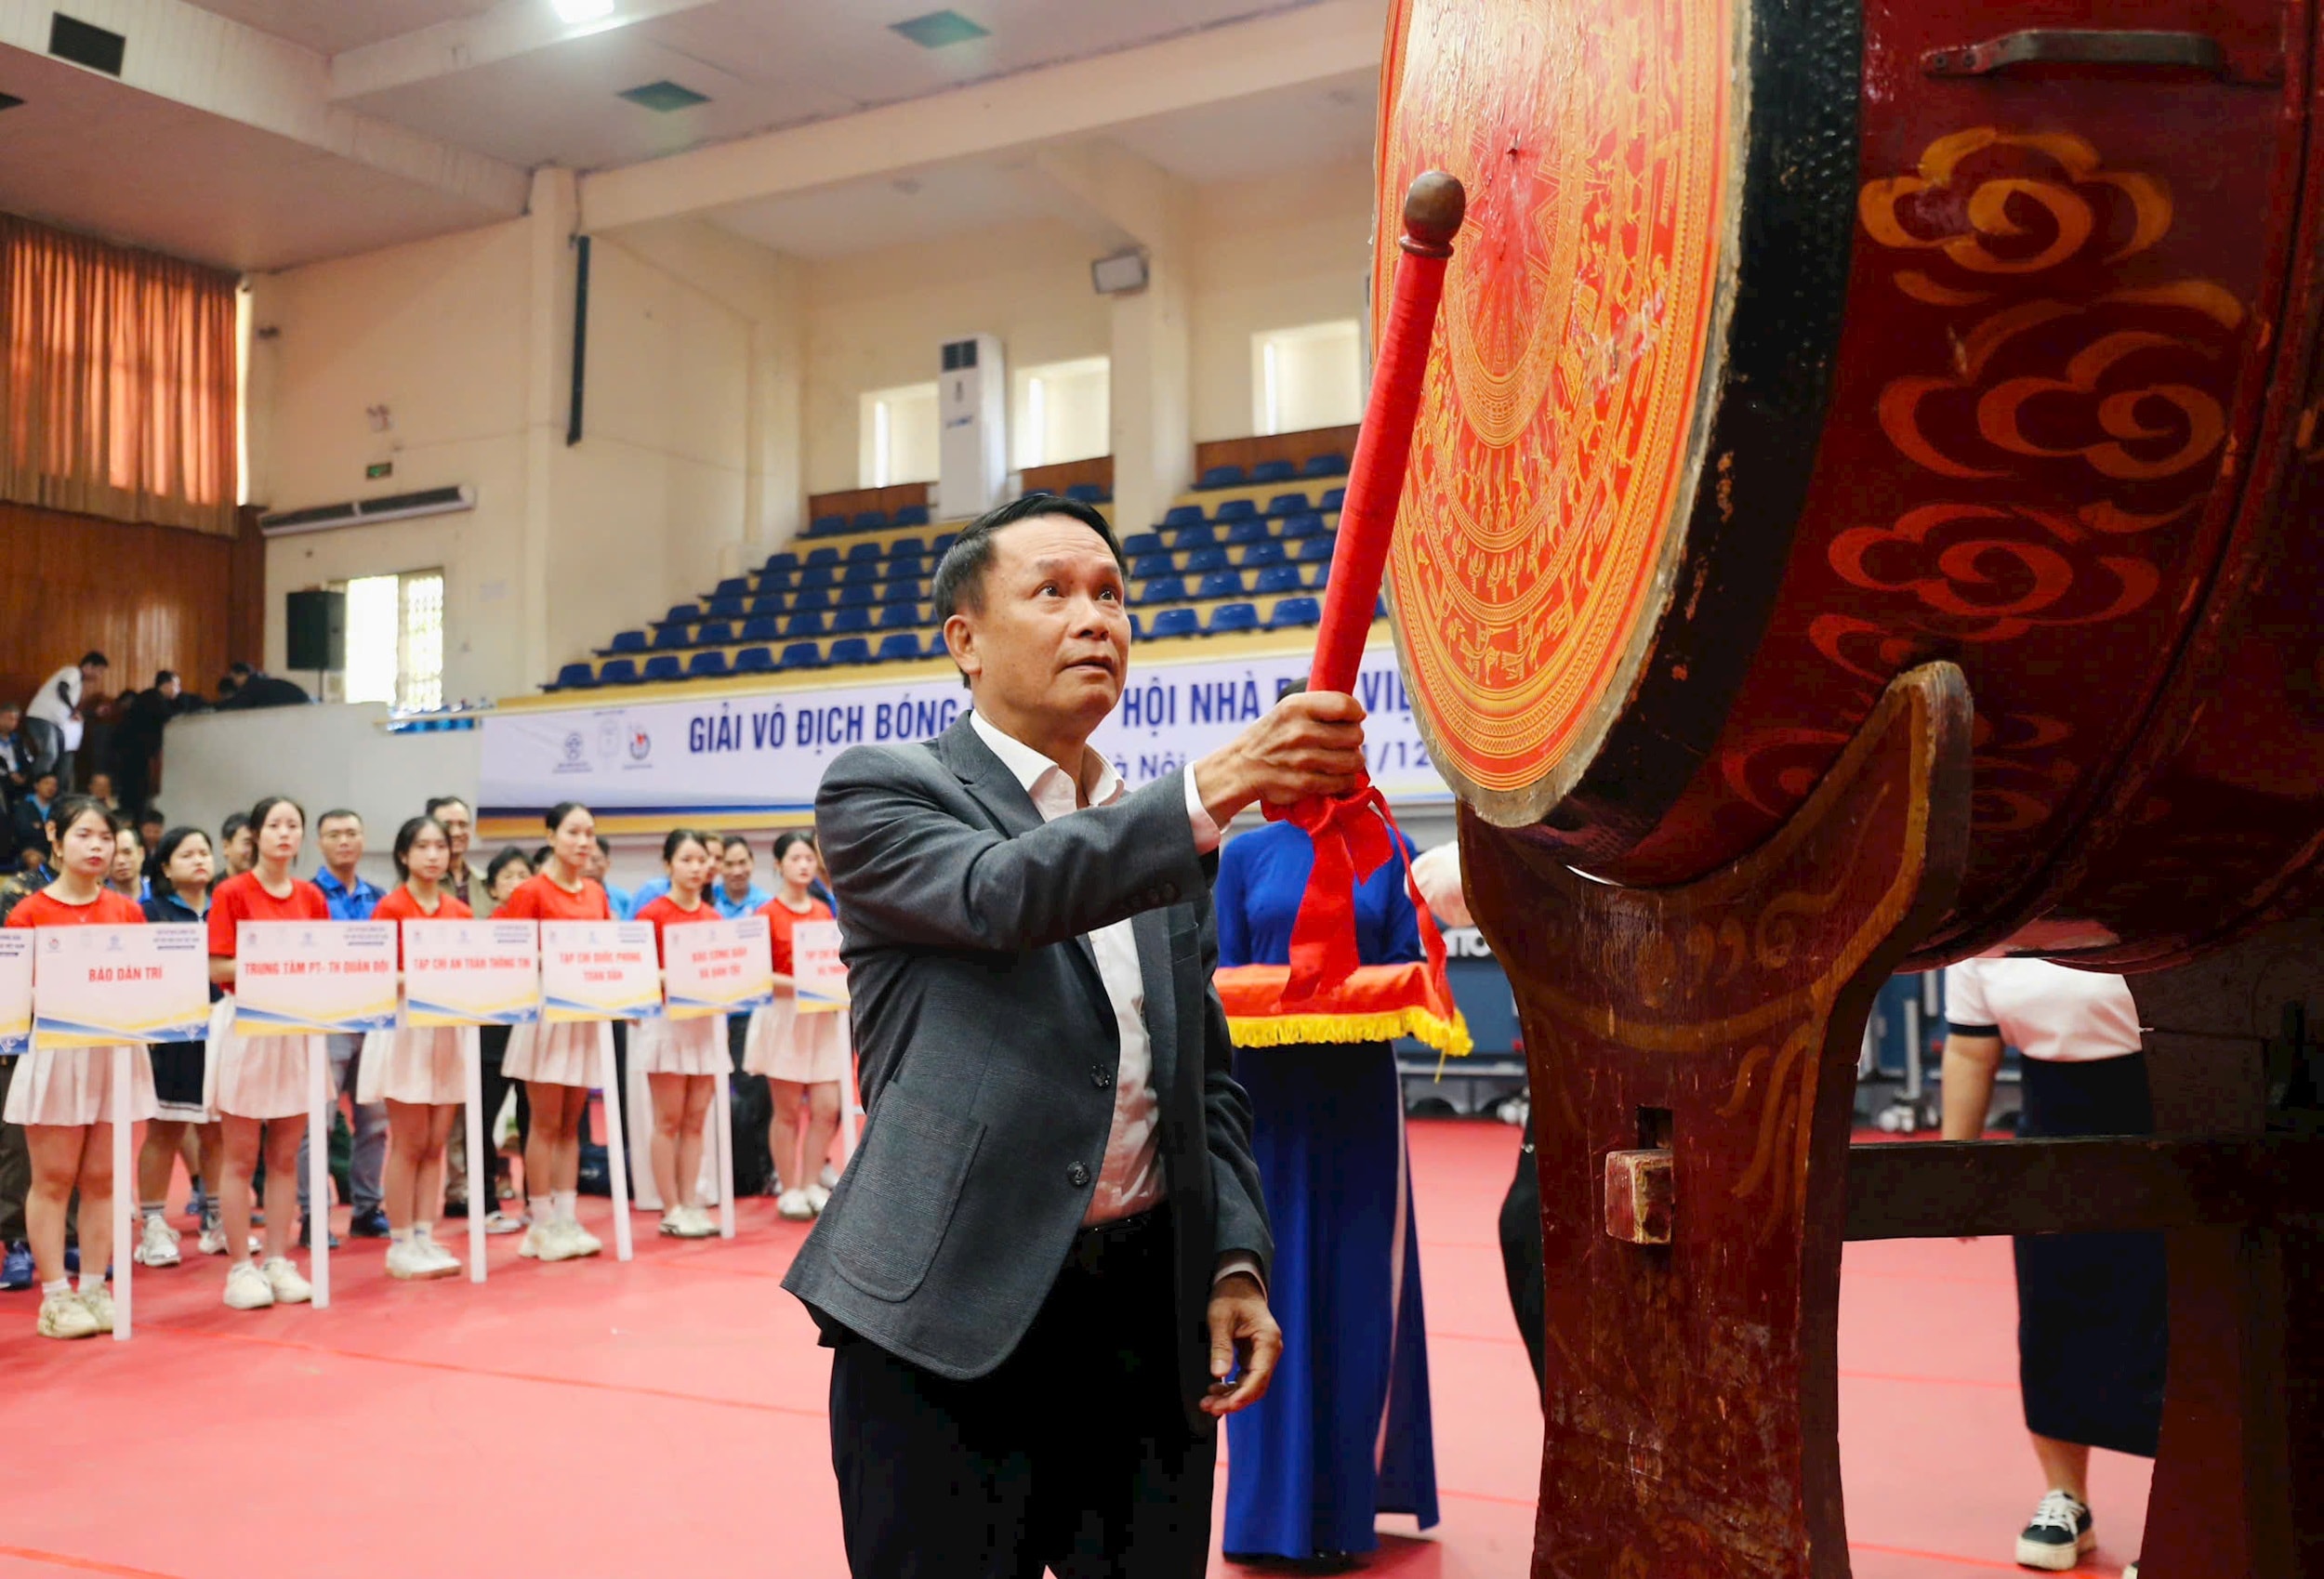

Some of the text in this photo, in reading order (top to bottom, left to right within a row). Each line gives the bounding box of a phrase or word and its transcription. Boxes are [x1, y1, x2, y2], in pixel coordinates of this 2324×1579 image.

[690, 701, 742, 754] GIẢI
[752, 702, 786, 750] VÔ
[797, 704, 864, 756] ĐỊCH
[876, 692, 957, 742] BÓNG
[1122, 676, 1176, 738] HỘI
[1190, 669, 1261, 725] NHÀ
[88, 965, 113, 982] BÁO
[117, 964, 142, 981] DÂN
